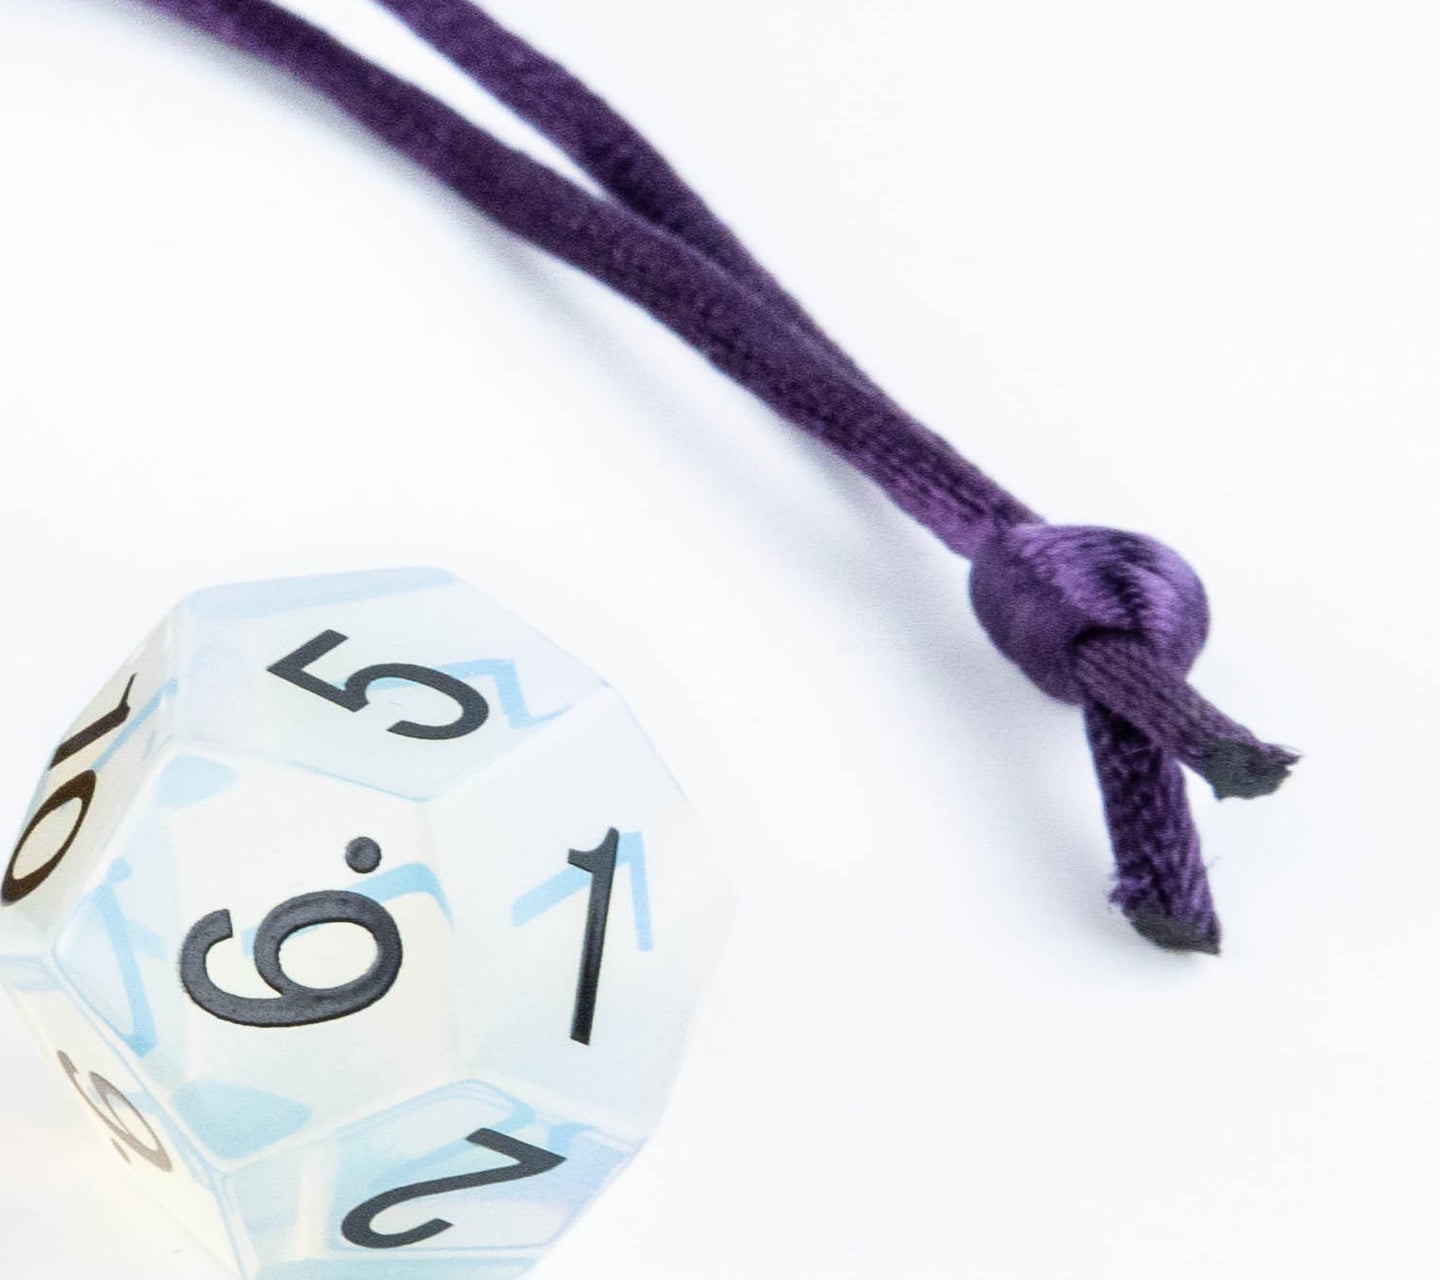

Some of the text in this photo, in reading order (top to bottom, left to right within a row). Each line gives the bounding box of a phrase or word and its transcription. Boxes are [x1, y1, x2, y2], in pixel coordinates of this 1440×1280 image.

[266, 629, 489, 741] 5
[0, 673, 137, 906] 10
[567, 827, 620, 1046] 1
[341, 1127, 566, 1249] 2
